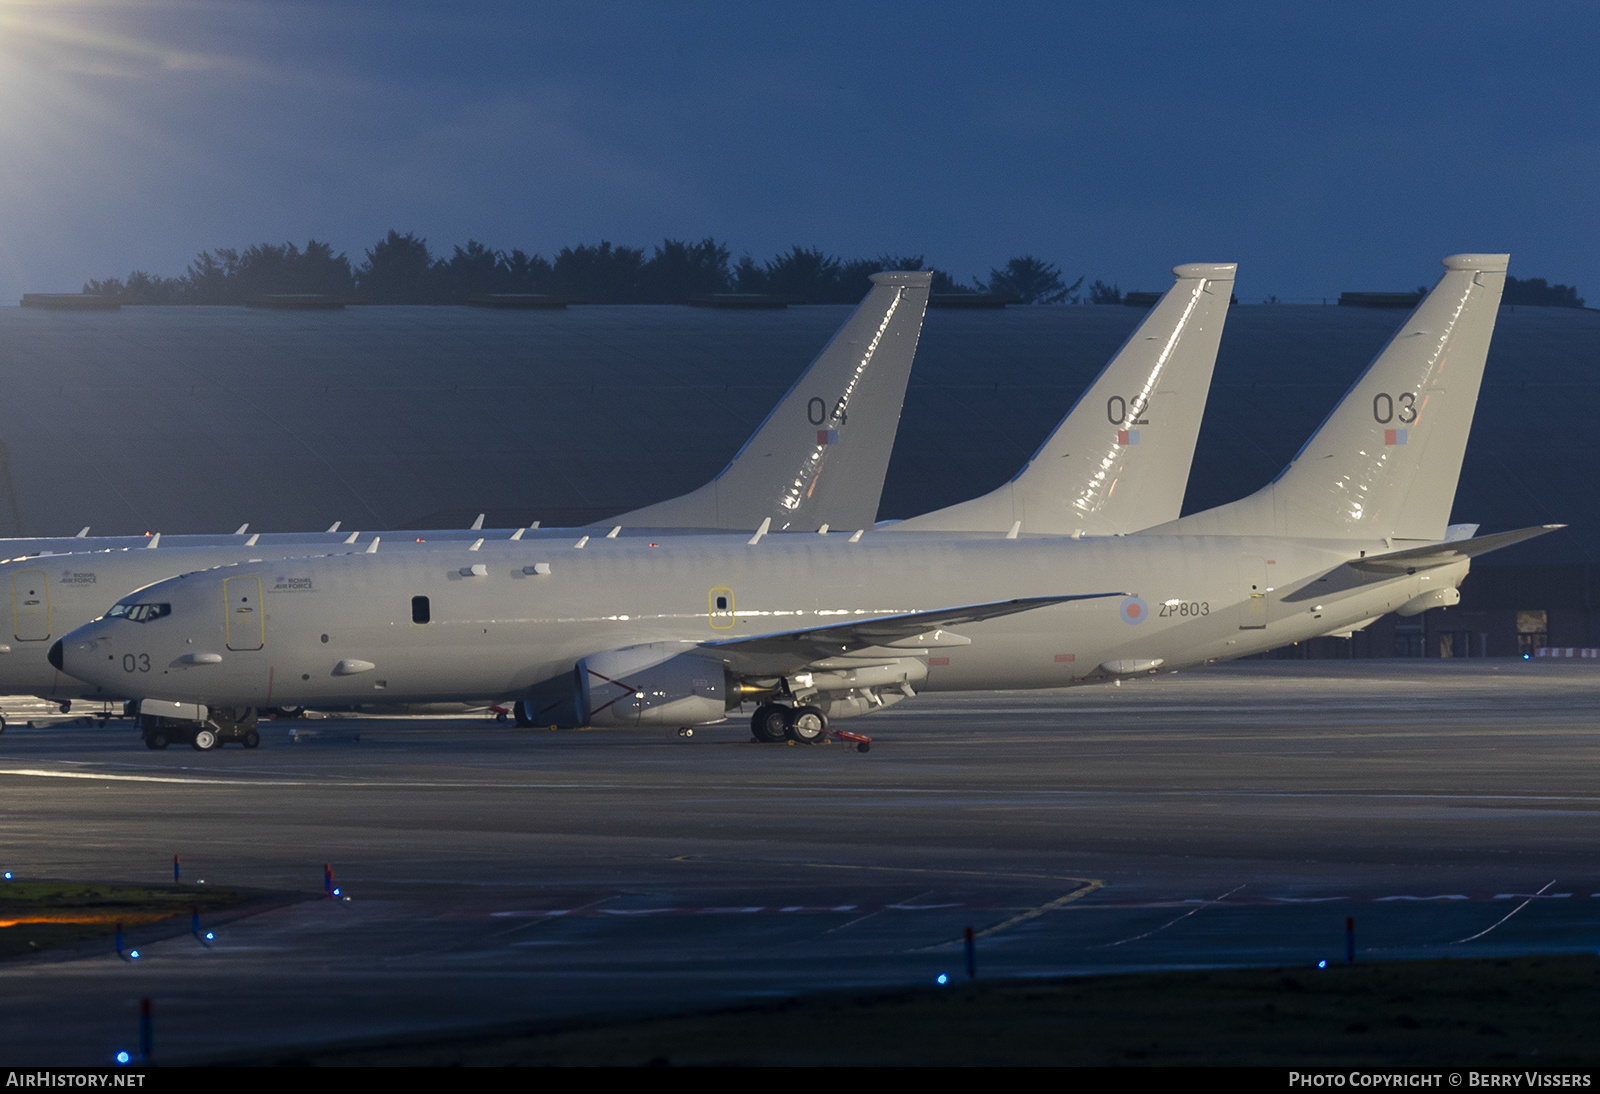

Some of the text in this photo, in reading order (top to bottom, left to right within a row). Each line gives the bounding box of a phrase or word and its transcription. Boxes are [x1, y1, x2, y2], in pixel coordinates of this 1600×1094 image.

[807, 396, 847, 425] 04
[1107, 395, 1149, 425] 02
[1373, 392, 1417, 424] 03
[1159, 601, 1209, 617] ZP803
[123, 653, 151, 673] 03
